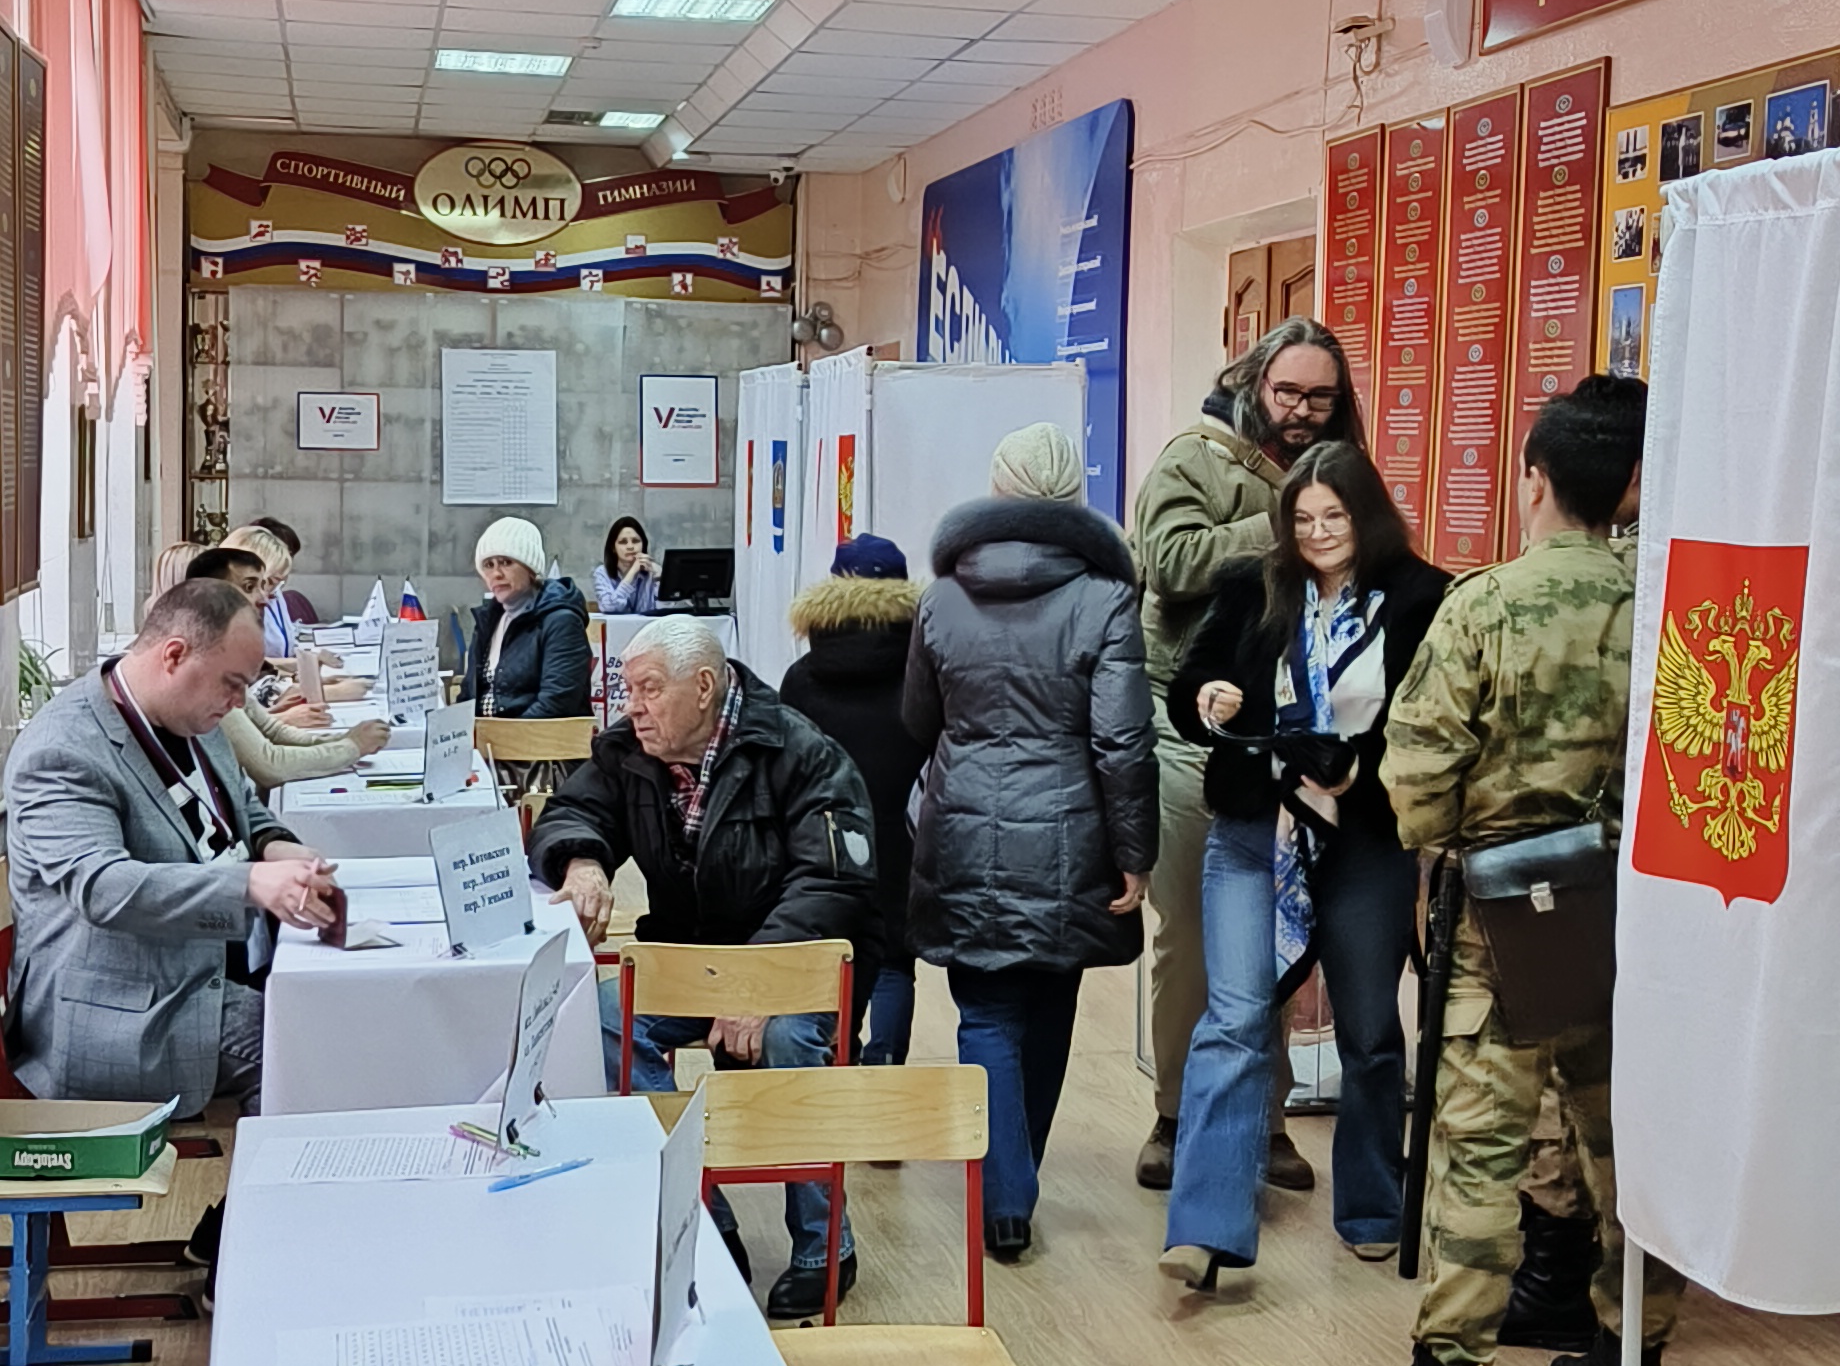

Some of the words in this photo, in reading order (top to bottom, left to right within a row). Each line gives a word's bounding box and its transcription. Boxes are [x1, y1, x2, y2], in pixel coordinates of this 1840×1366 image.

[276, 157, 406, 202] СПОРТИВНЫЙ
[432, 192, 567, 222] ОЛИМП
[598, 178, 696, 205] ГИМНАЗИИ
